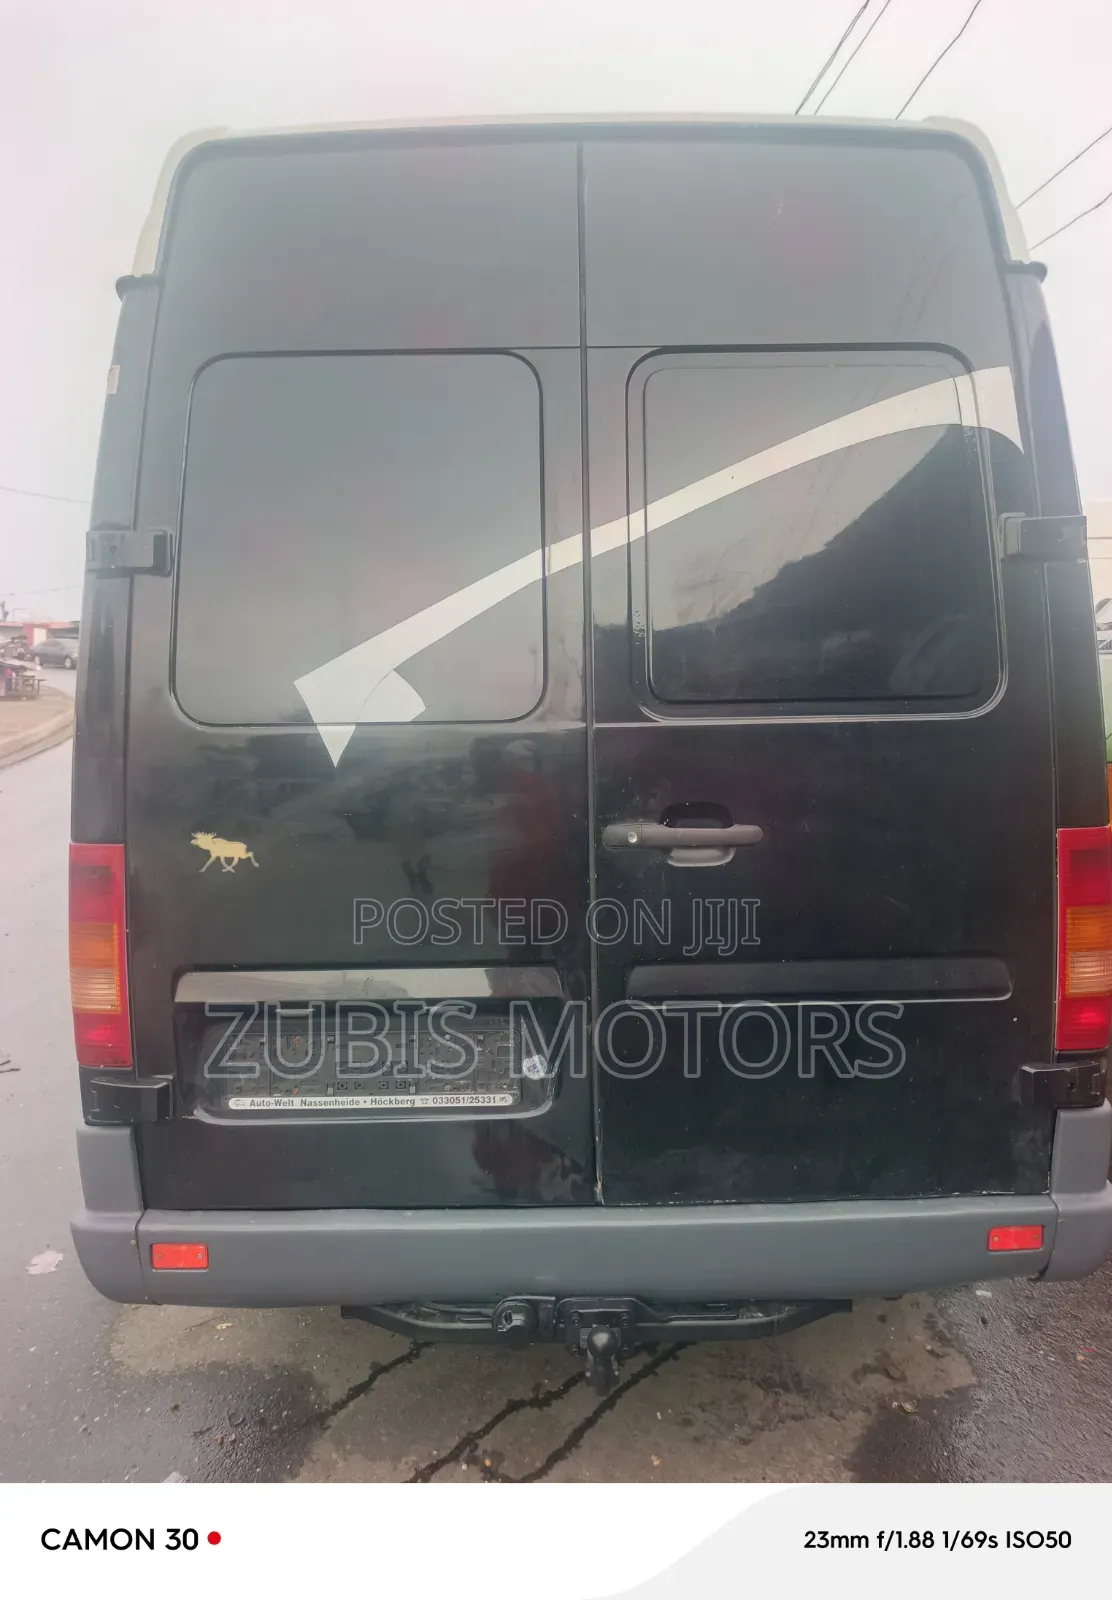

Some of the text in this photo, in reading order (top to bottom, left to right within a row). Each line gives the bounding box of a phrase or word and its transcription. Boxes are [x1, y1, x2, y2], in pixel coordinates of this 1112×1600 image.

[249, 1096, 497, 1107] Auto-Welt Nassenheide Höckberg 033051/25331
